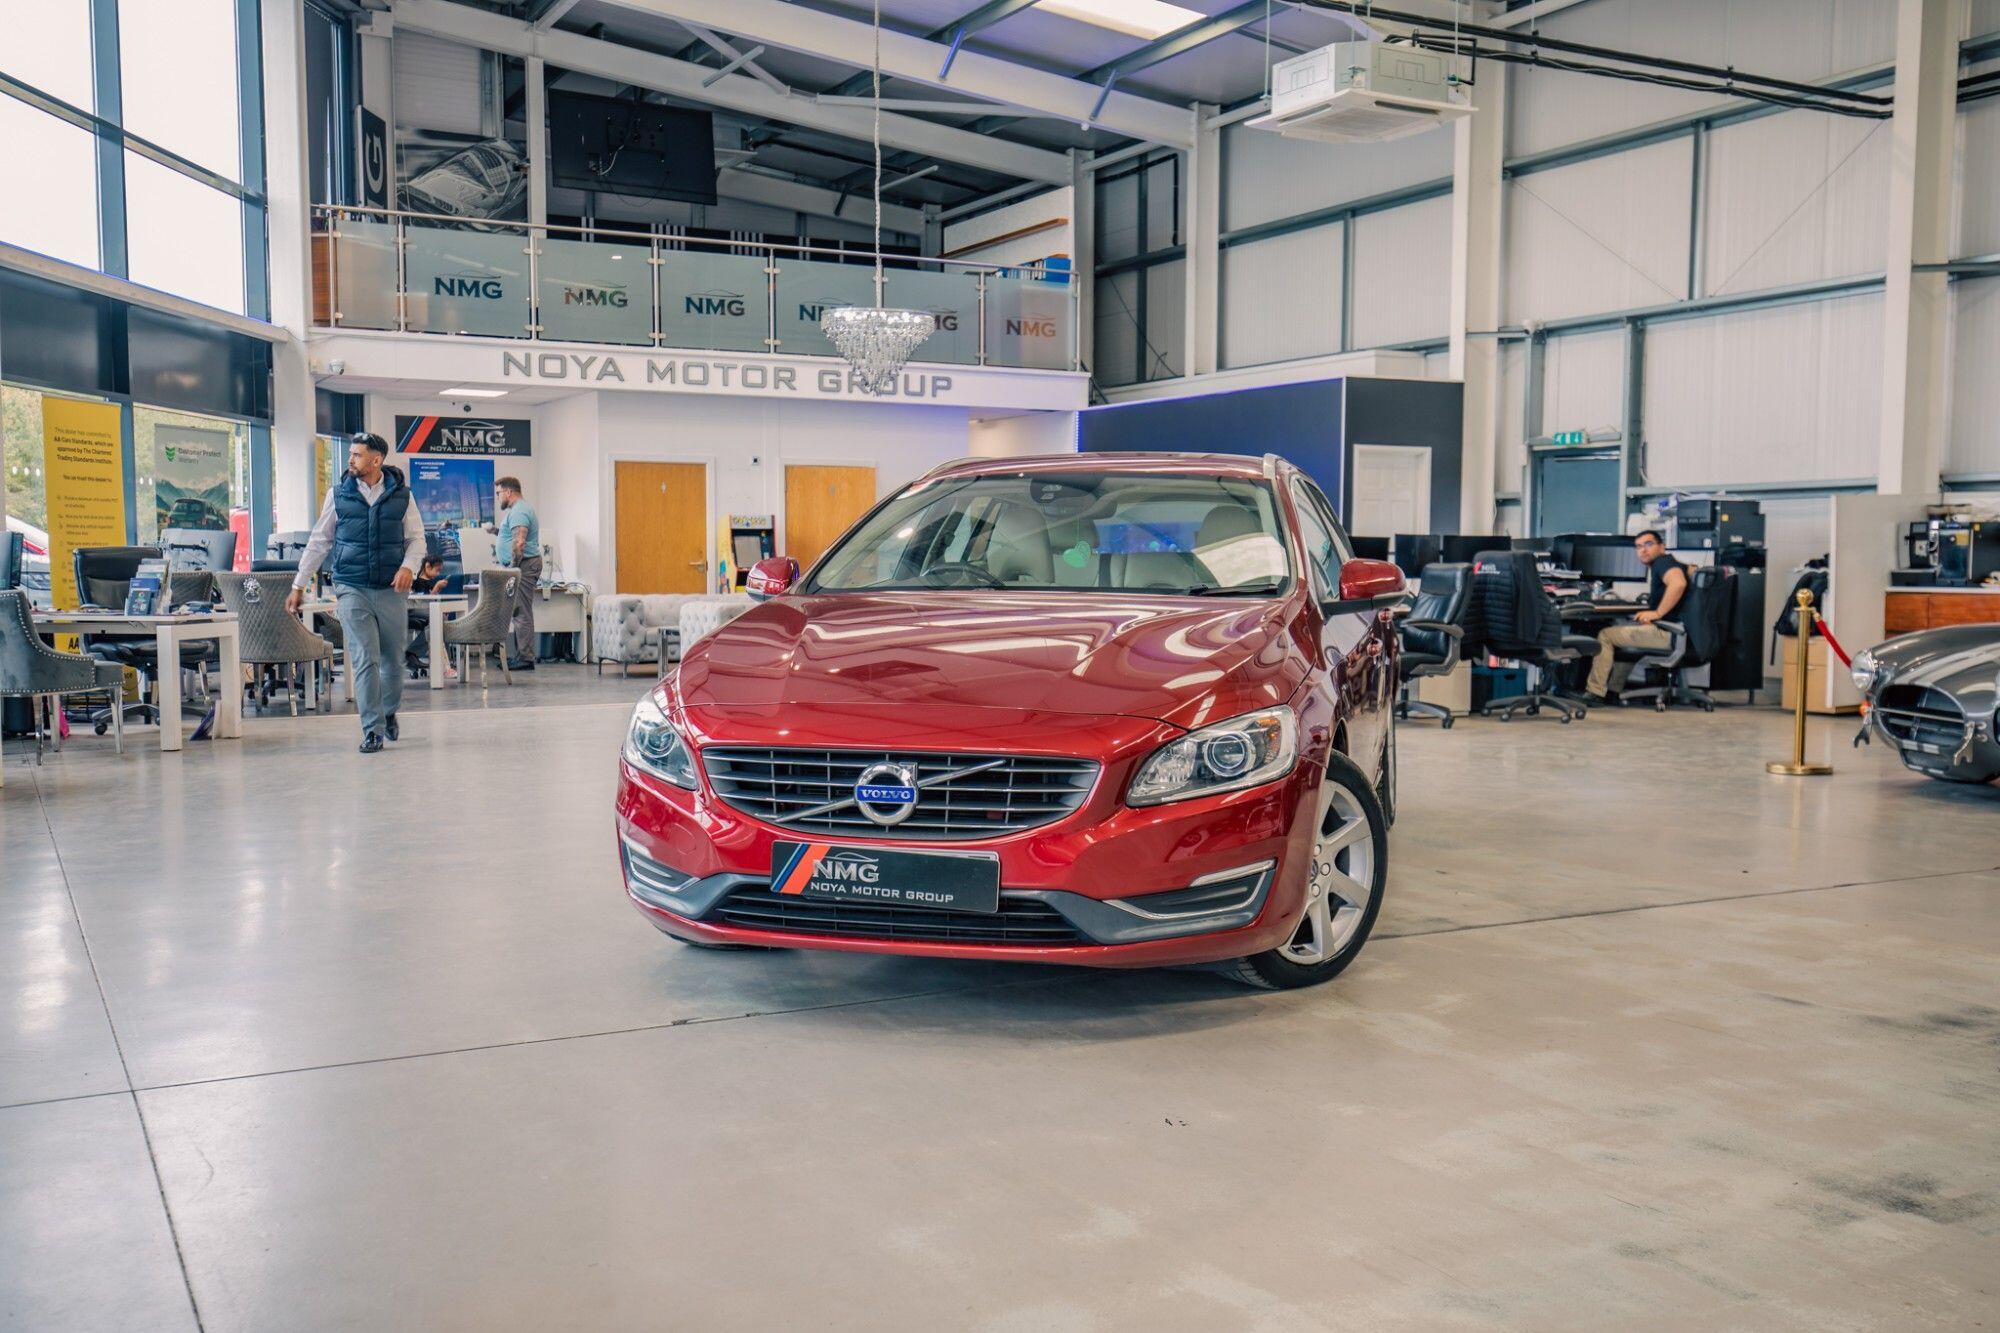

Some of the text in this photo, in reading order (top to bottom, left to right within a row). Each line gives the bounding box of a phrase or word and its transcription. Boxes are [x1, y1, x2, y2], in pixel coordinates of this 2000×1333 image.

[434, 276, 503, 300] NMG
[564, 287, 629, 308] NMG
[685, 296, 745, 317] NMG
[1006, 319, 1057, 338] NMG
[503, 351, 625, 382] NOYA
[646, 359, 797, 391] MOTOR
[440, 428, 506, 448] NMG
[860, 788, 911, 800] VOLVO
[812, 858, 880, 883] NMG
[810, 881, 954, 903] NOYA MOTOR GROUP
